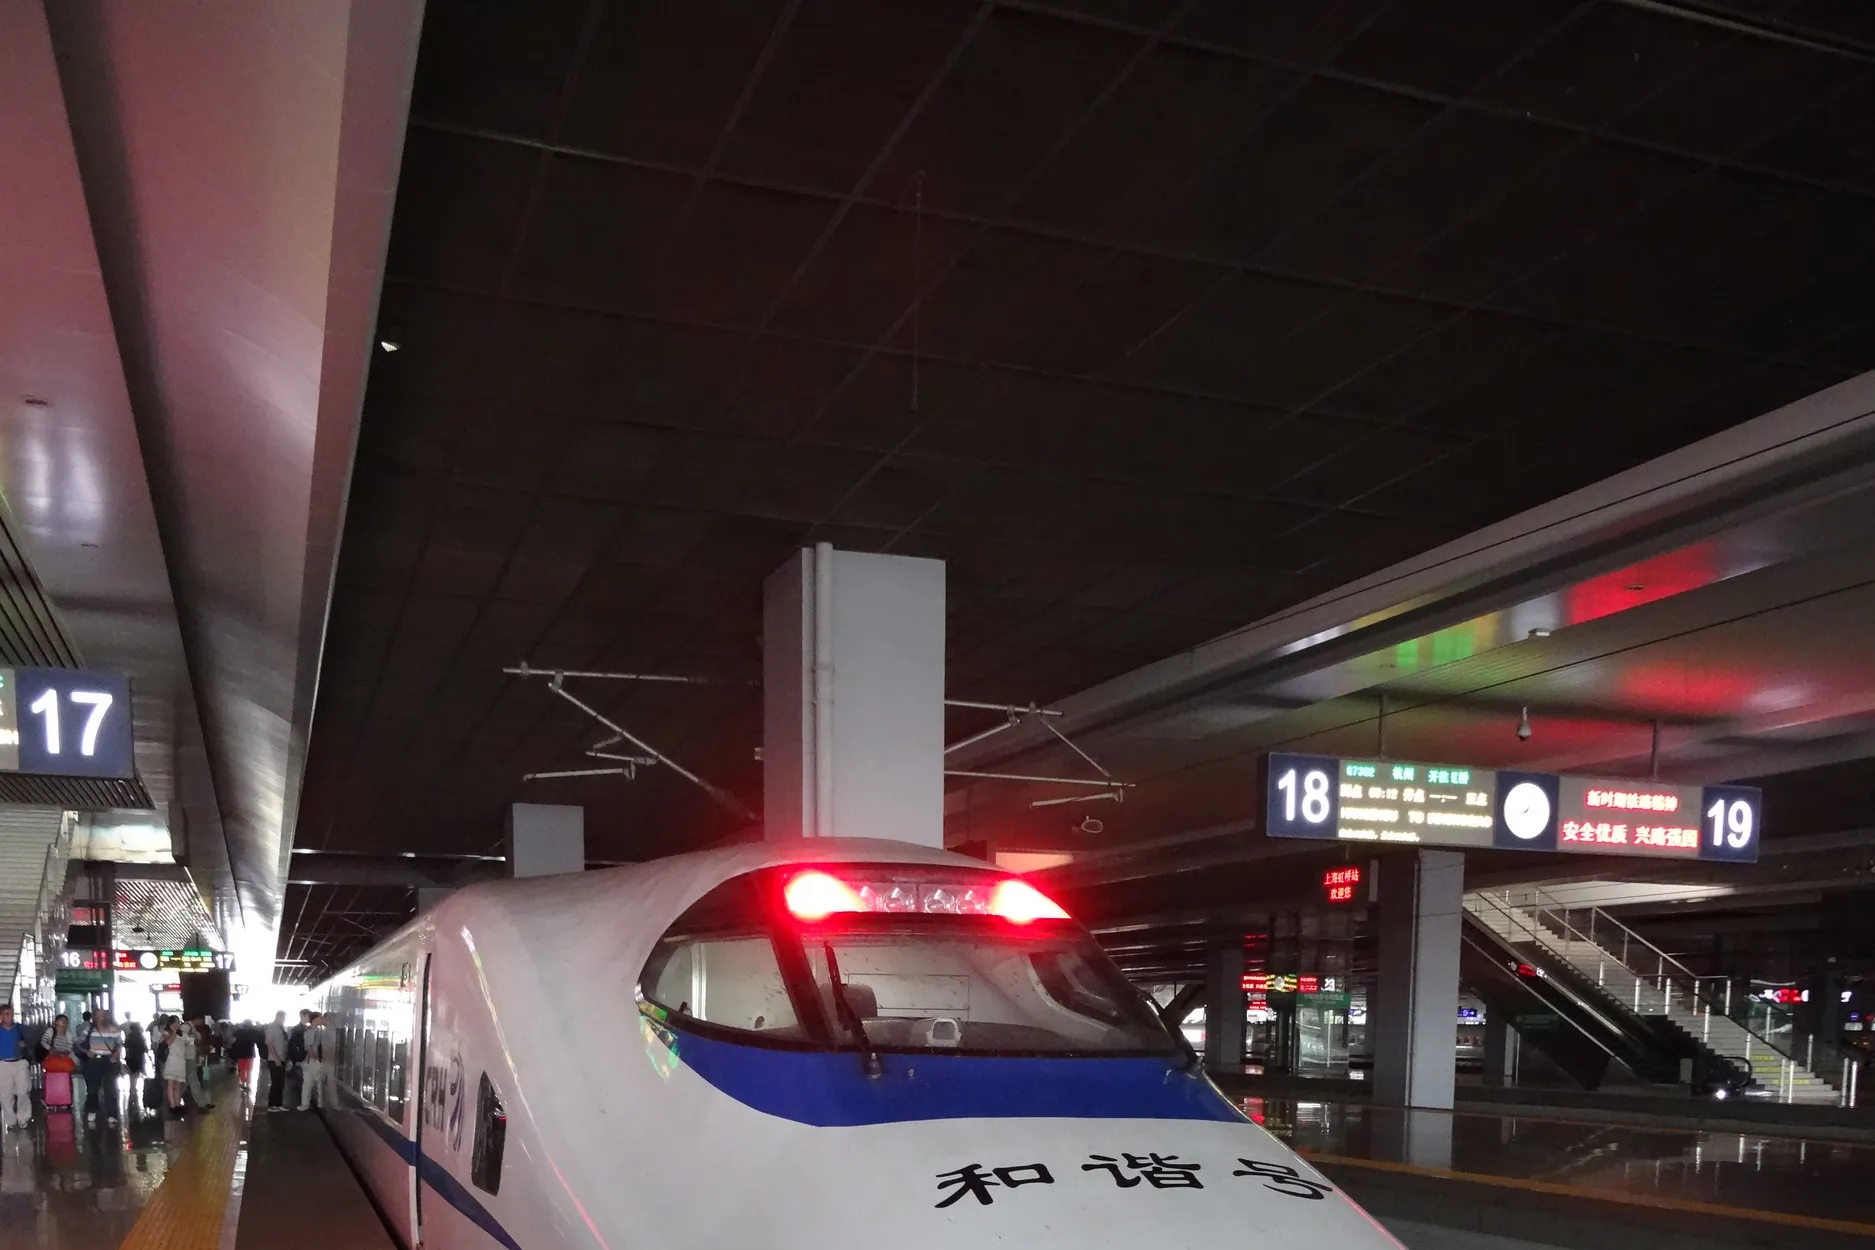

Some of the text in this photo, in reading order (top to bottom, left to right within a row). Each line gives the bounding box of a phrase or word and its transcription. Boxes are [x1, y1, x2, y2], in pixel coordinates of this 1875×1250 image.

[31, 688, 113, 756] 17
[1278, 769, 1330, 824] 18
[1563, 821, 1628, 845] 安全优质
[1707, 798, 1753, 849] 19
[1324, 868, 1359, 885] 上海虹桥站
[1330, 886, 1352, 900] 欢迎您
[61, 951, 81, 968] 16
[215, 953, 234, 969] 17
[425, 1065, 448, 1132] CRH
[934, 1152, 1334, 1208] 和谐号
